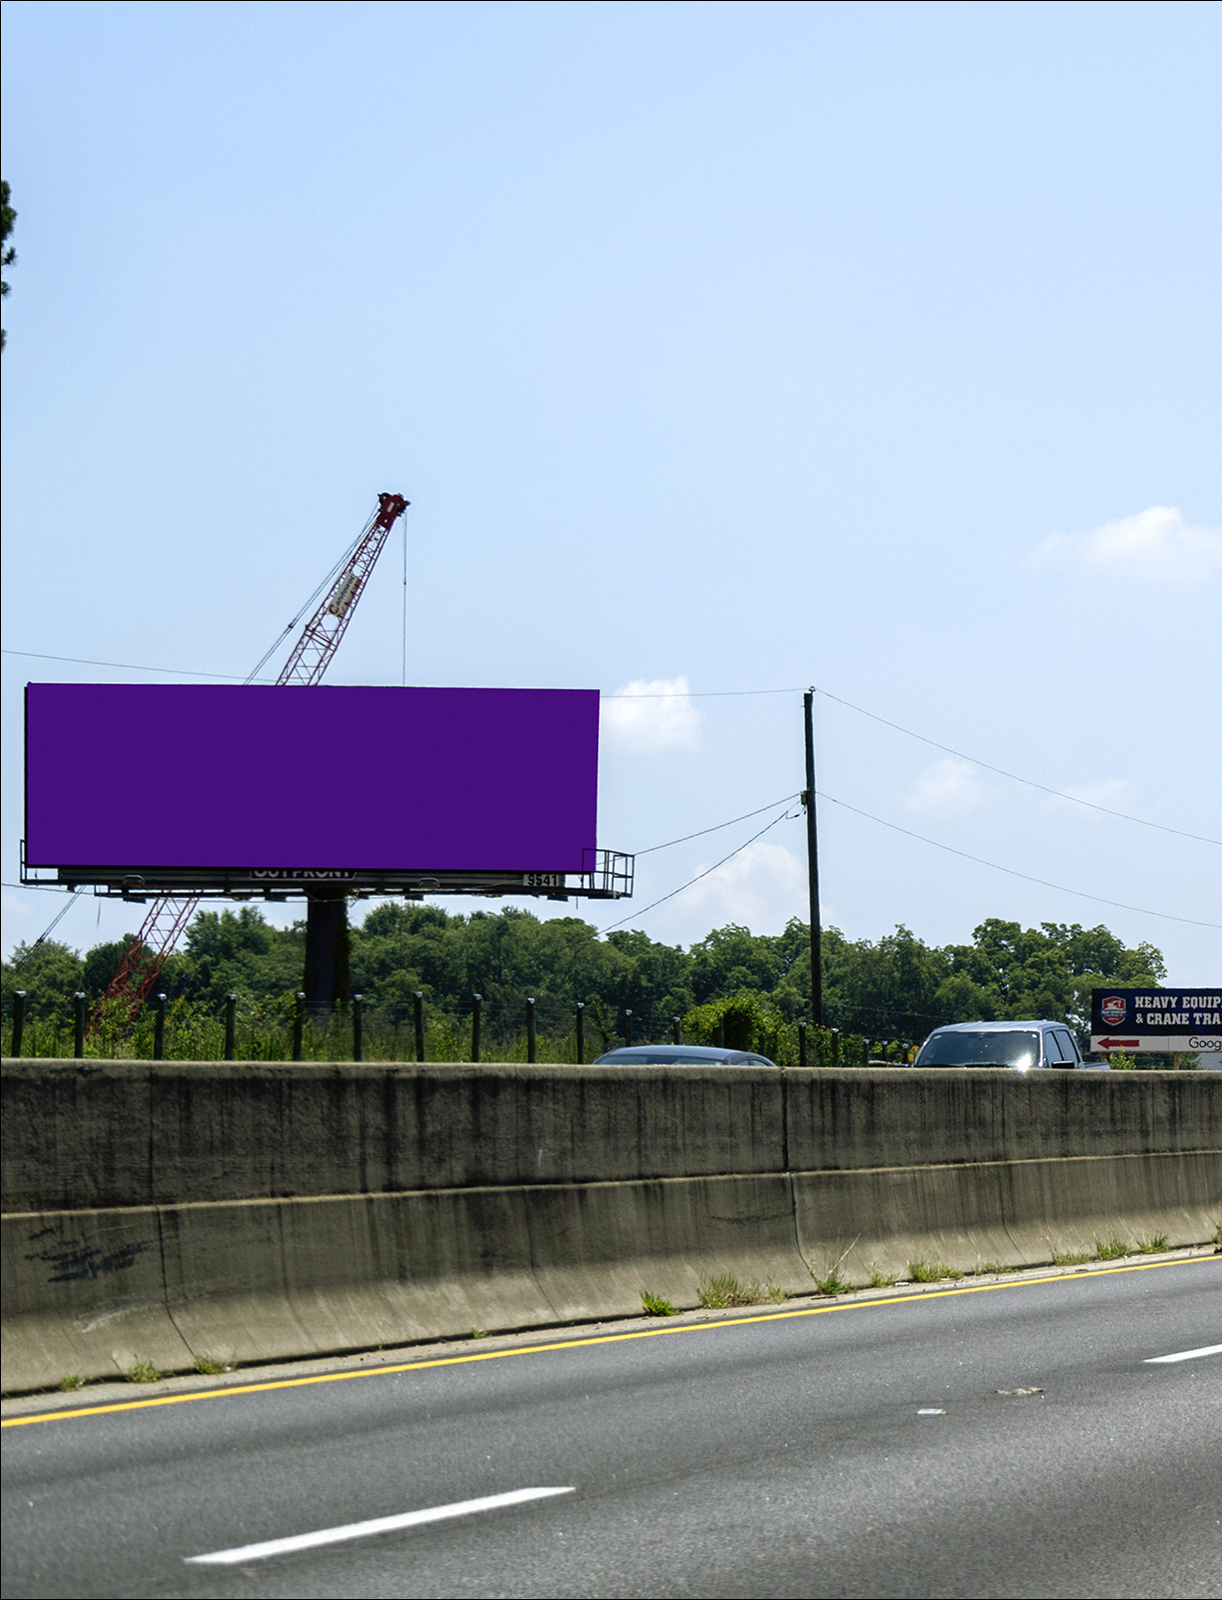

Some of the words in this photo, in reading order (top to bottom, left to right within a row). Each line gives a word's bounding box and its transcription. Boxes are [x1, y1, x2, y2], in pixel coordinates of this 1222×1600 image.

[1134, 996, 1178, 1009] HEAVY
[1135, 1013, 1144, 1024] &
[1146, 1013, 1190, 1025] CRANE
